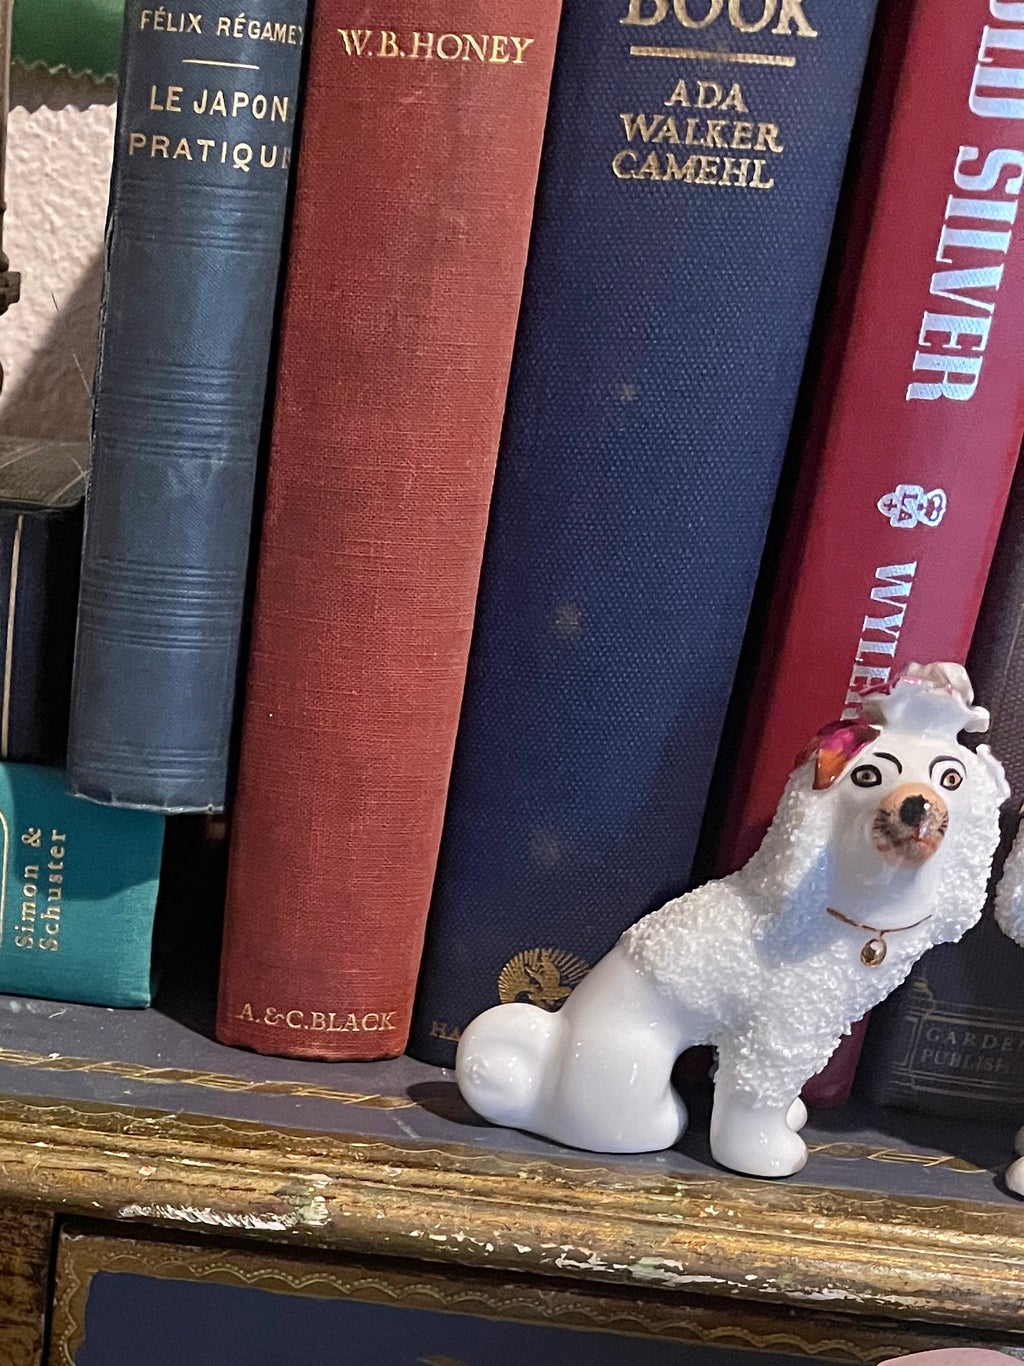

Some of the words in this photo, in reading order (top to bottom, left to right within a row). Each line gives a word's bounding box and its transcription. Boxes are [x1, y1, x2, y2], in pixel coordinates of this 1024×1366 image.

[140, 6, 202, 35] FÉLIX
[150, 85, 184, 112] LE
[193, 89, 289, 122] JAPON
[664, 78, 749, 113] ADA
[619, 113, 784, 153] WALKER
[611, 149, 775, 189] CAMEHL
[906, 145, 1024, 401] SILVER
[21, 827, 42, 848] &
[14, 864, 40, 949] Simon
[39, 829, 67, 951] Schuster
